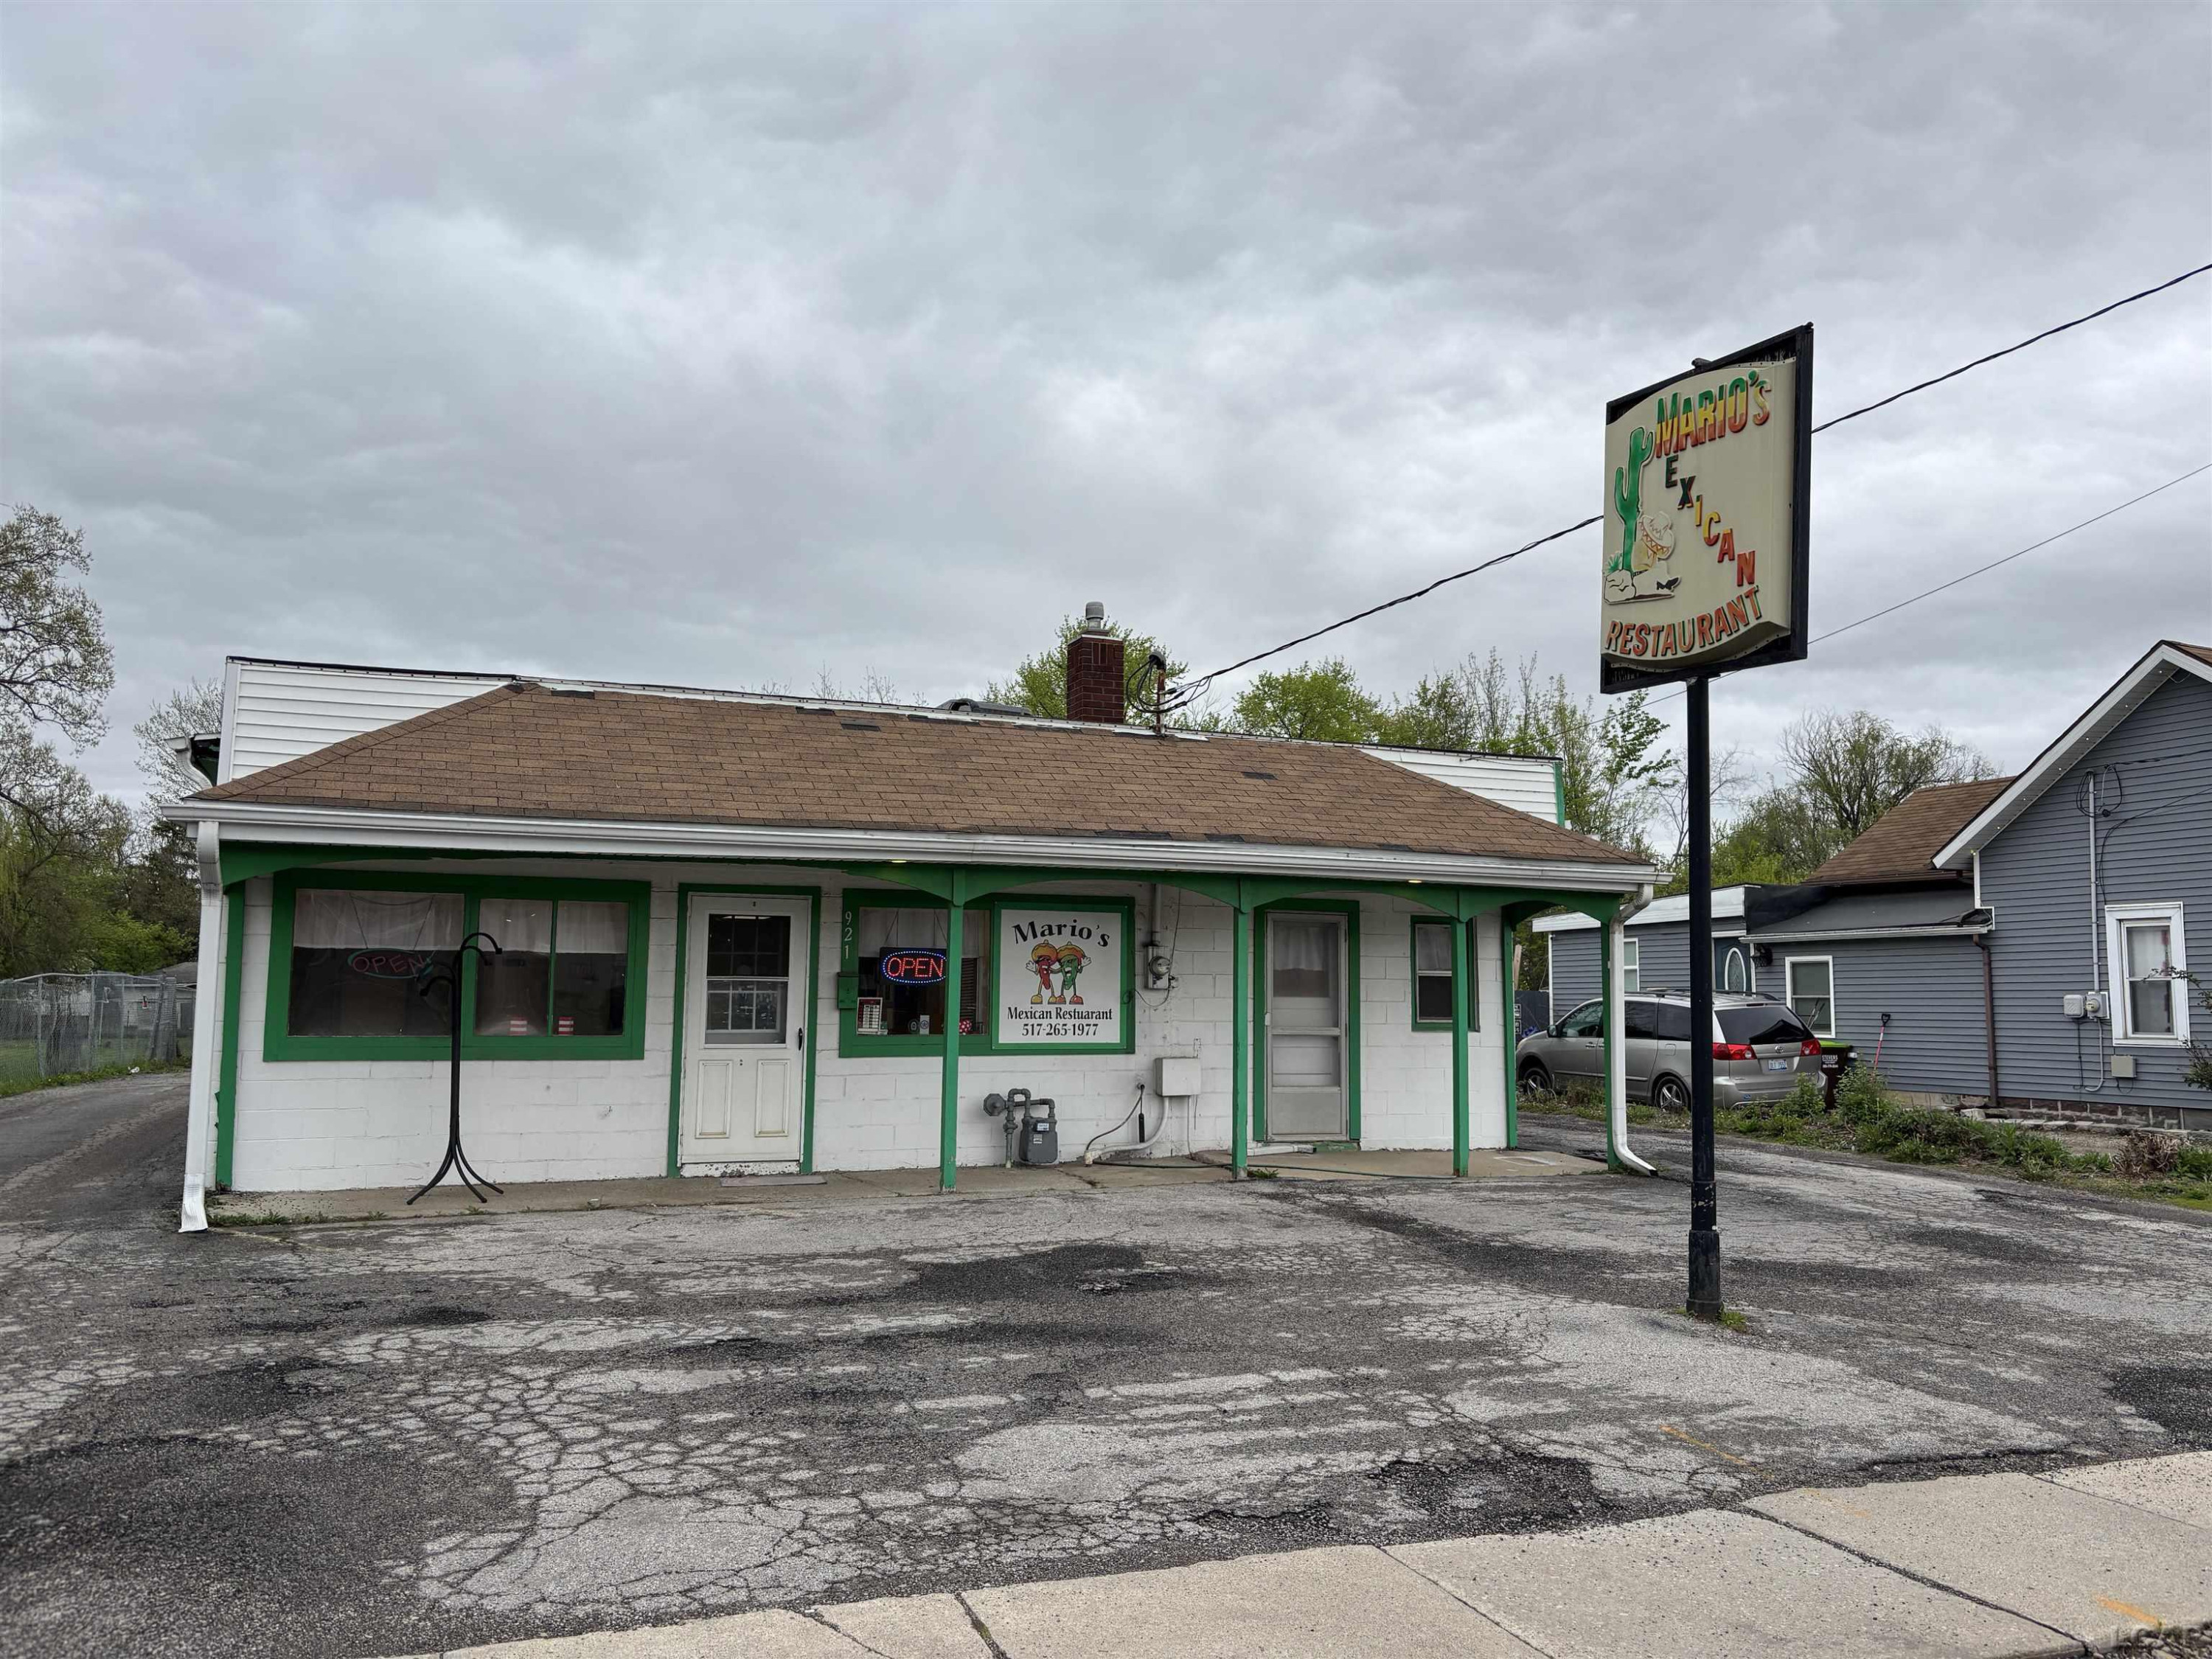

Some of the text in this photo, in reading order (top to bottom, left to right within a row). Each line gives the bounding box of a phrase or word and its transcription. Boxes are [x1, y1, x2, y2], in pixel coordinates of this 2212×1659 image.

[1655, 369, 1772, 459] MARIO'S
[1604, 585, 1764, 658] RESTAURANT
[844, 911, 852, 959] 921
[1011, 919, 1110, 947] Mario's
[352, 954, 425, 975] OPEN
[887, 957, 944, 978] OPEN
[1007, 1006, 1113, 1020] Mexican Restuarant
[1021, 1023, 1099, 1037] 517-265-1977
